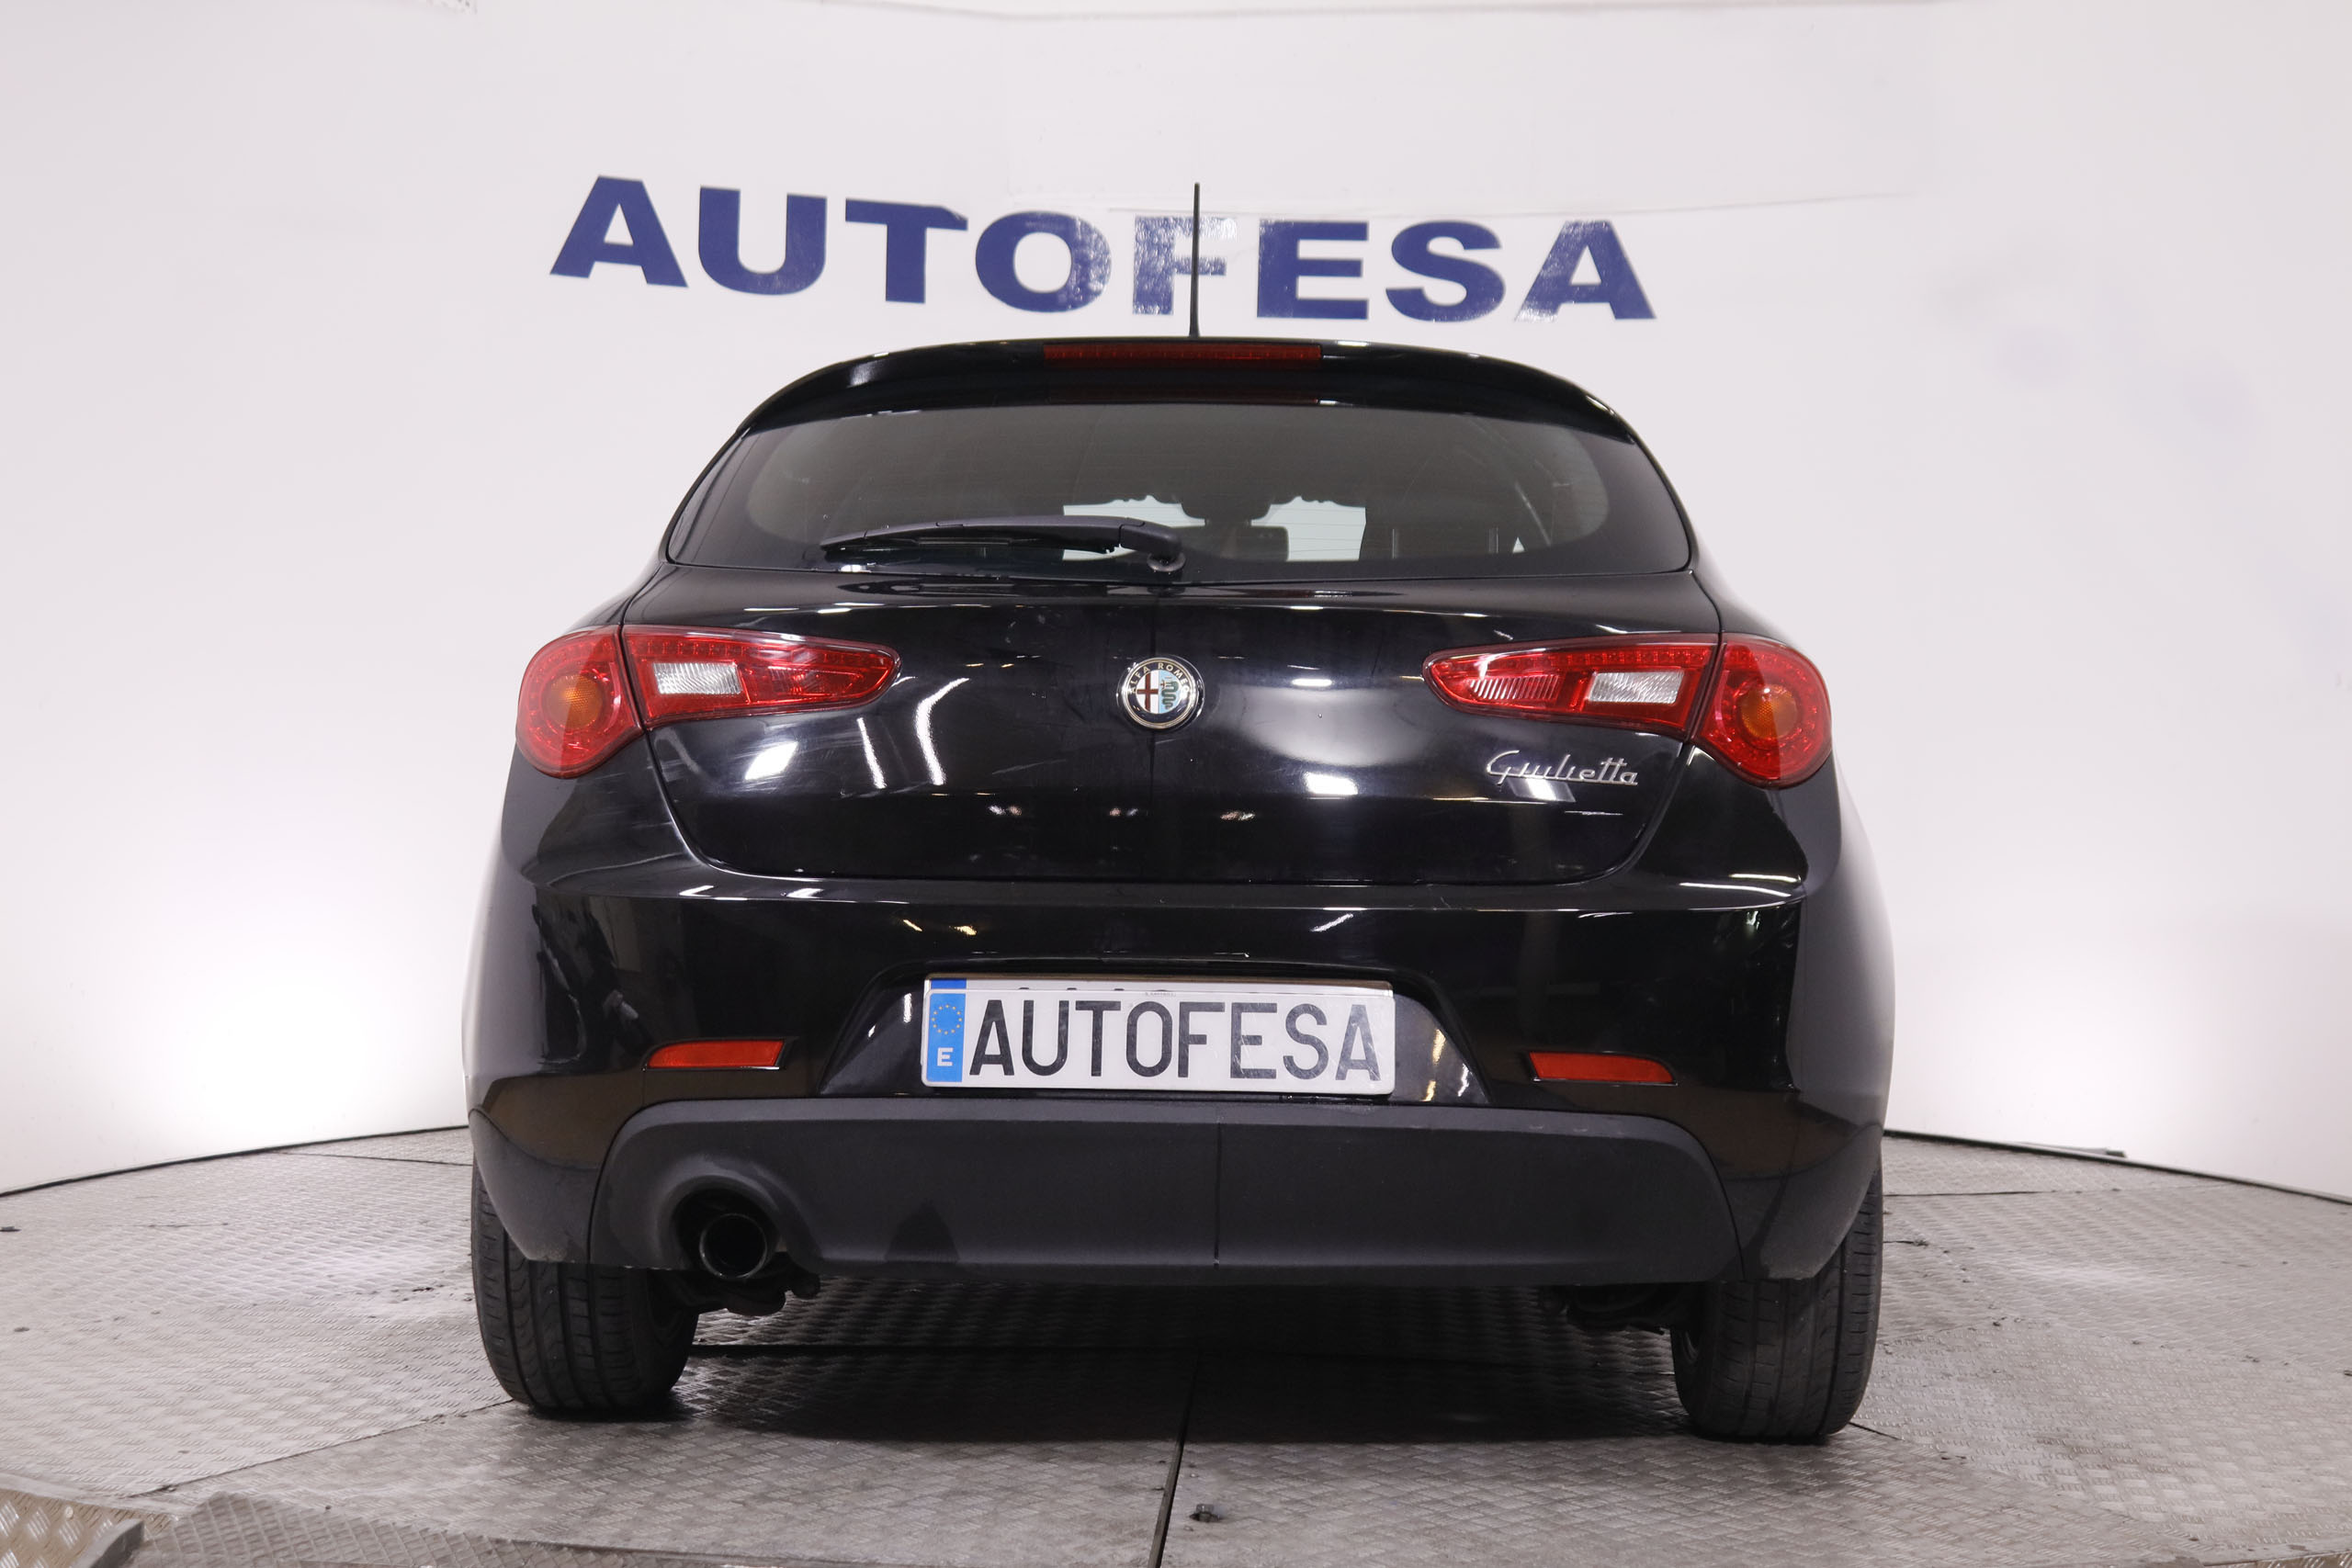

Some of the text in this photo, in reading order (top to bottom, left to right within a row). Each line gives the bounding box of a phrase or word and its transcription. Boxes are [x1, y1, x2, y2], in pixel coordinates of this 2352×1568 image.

[549, 175, 1657, 323] AUTOFESA
[1129, 666, 1150, 694] ALFA
[1487, 750, 1638, 785] Giulietta
[937, 999, 1381, 1081] E AUTOFESA
